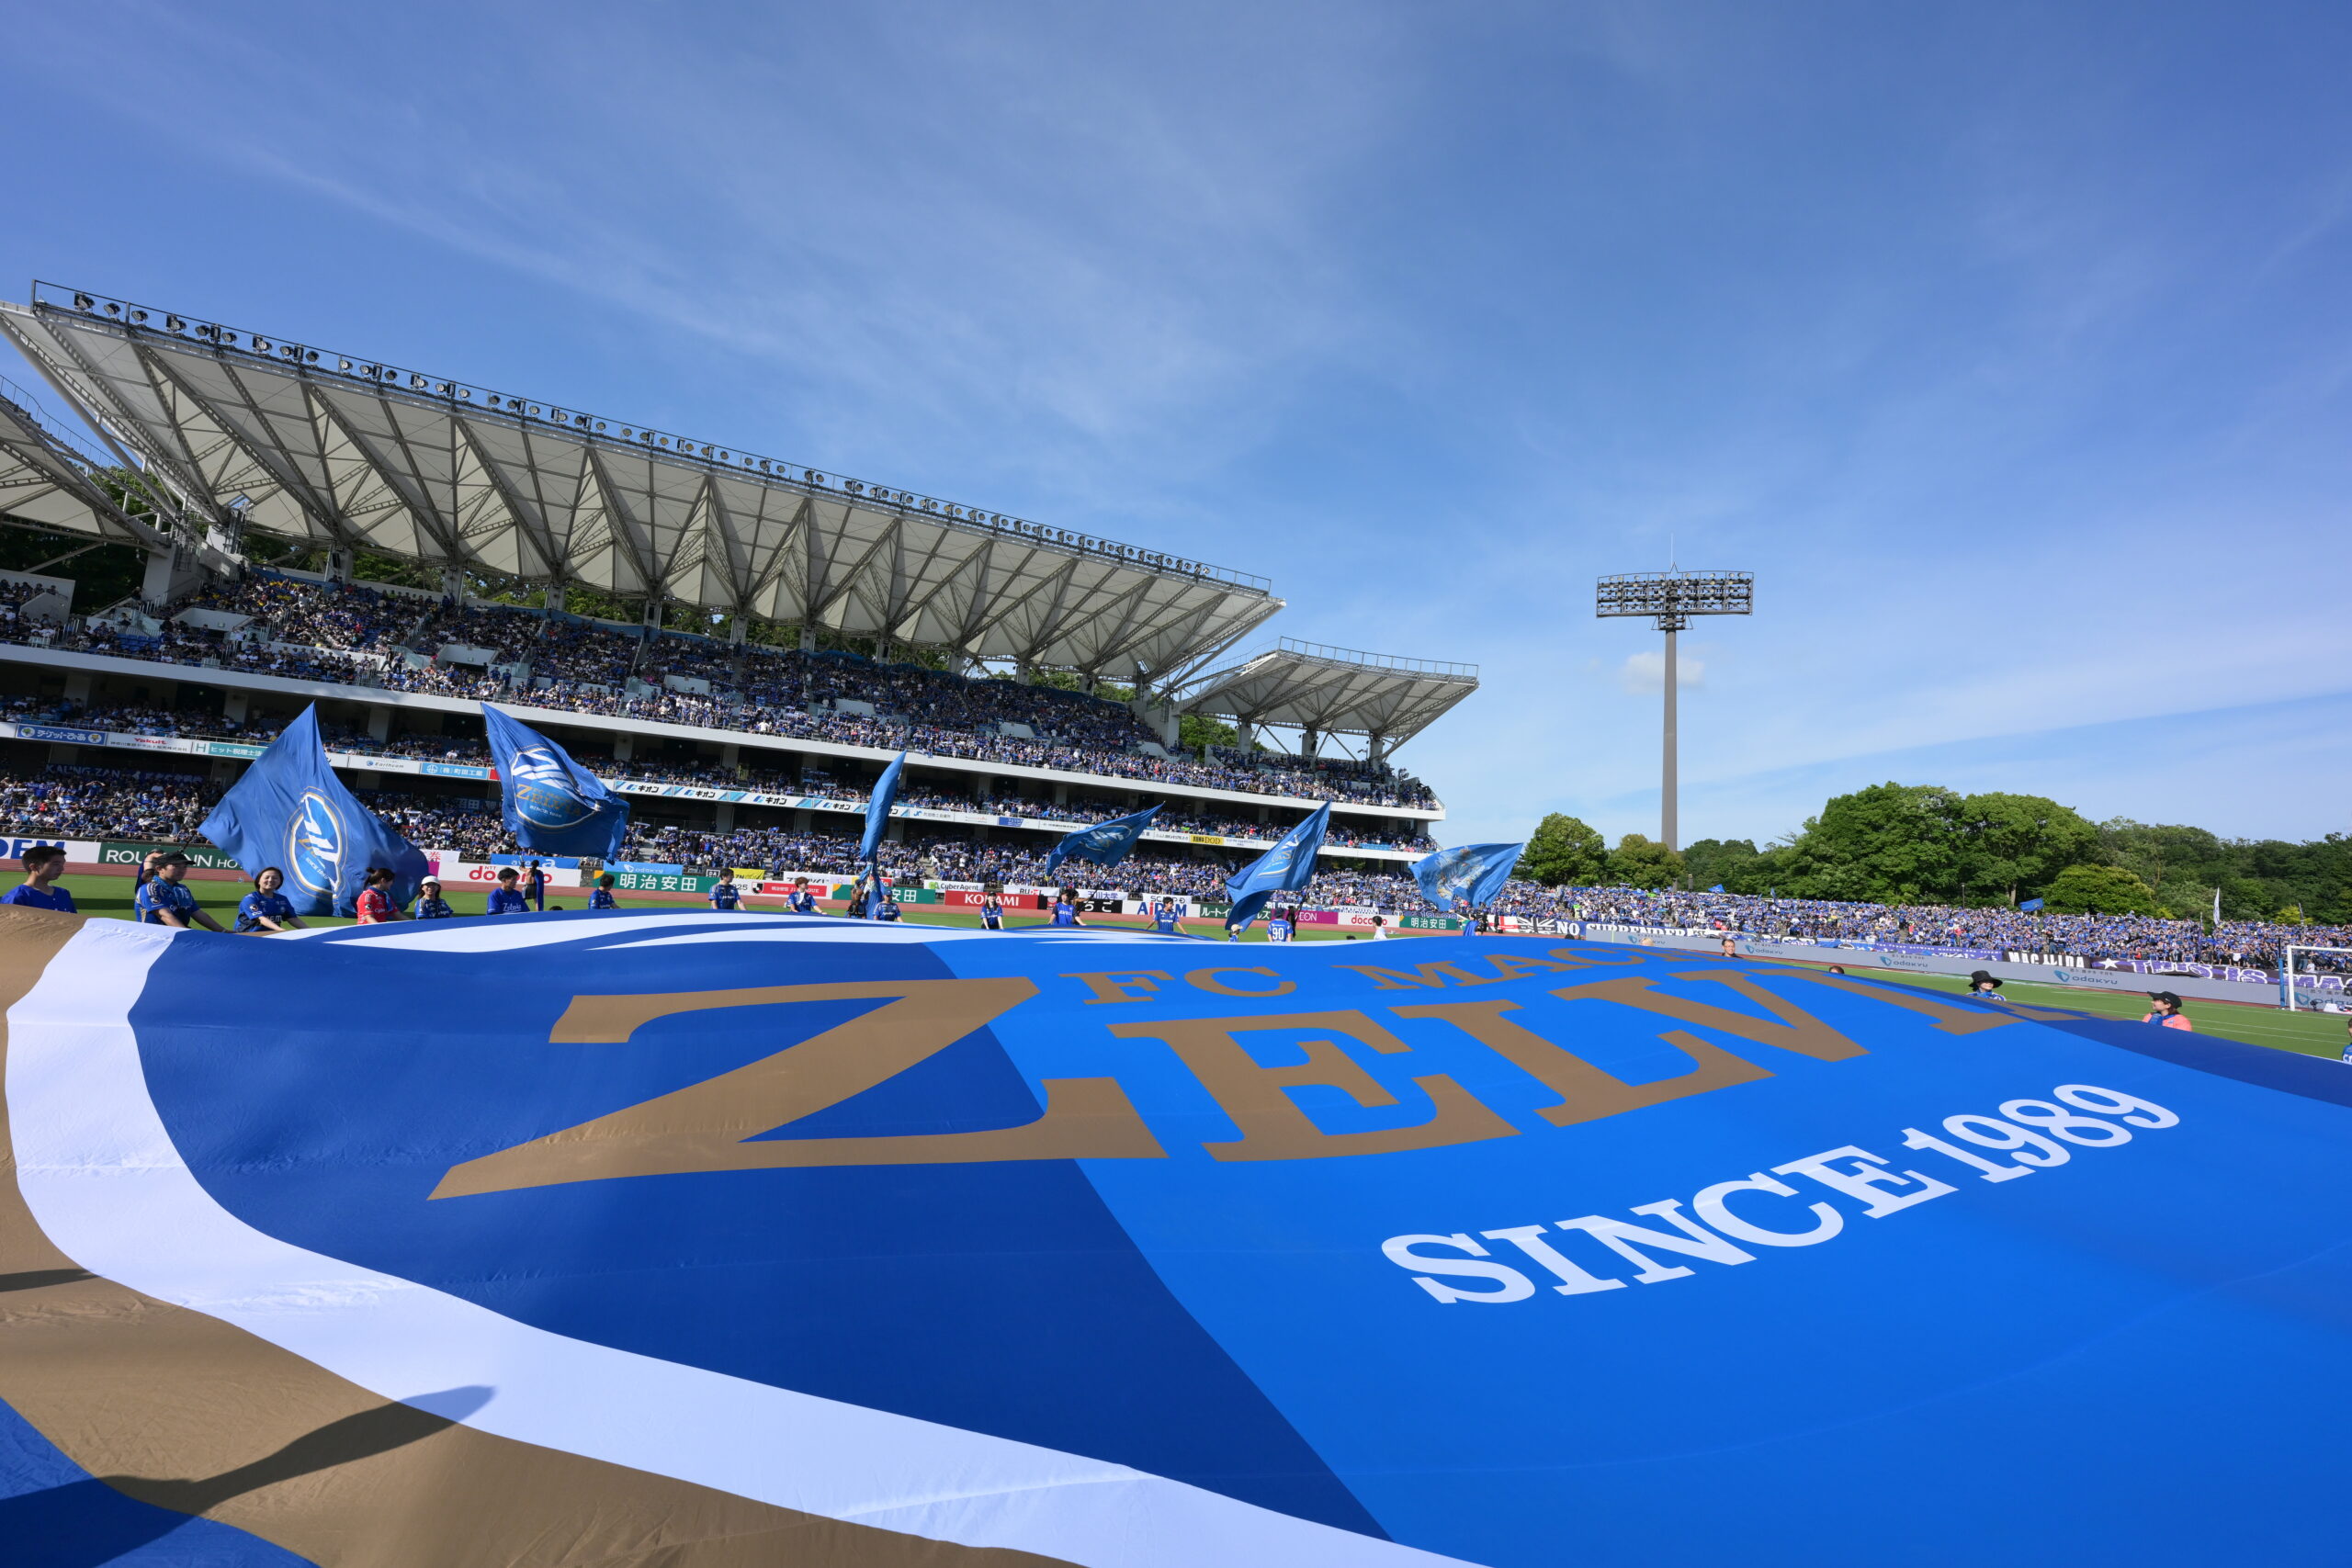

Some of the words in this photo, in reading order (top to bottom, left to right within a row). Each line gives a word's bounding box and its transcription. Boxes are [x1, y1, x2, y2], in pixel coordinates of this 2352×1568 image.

[37, 729, 86, 741] チケットぴあ
[134, 737, 167, 745] Yakult
[619, 874, 697, 892] 明治安田
[941, 883, 978, 892] CyberAgent
[891, 888, 917, 903] 安田
[1137, 901, 1187, 918] AiDM
[1410, 917, 1447, 930] 明治安田
[1556, 920, 1580, 935] NO
[1272, 927, 1284, 941] 90
[1755, 947, 1783, 955] odakyu
[1893, 959, 1928, 968] odakyu
[1059, 966, 1297, 1006] FC
[2072, 976, 2118, 985] odakyu
[427, 969, 2133, 1201] ZELVI
[1381, 1145, 1961, 1304] SINCE
[1901, 1083, 2181, 1184] 1989
